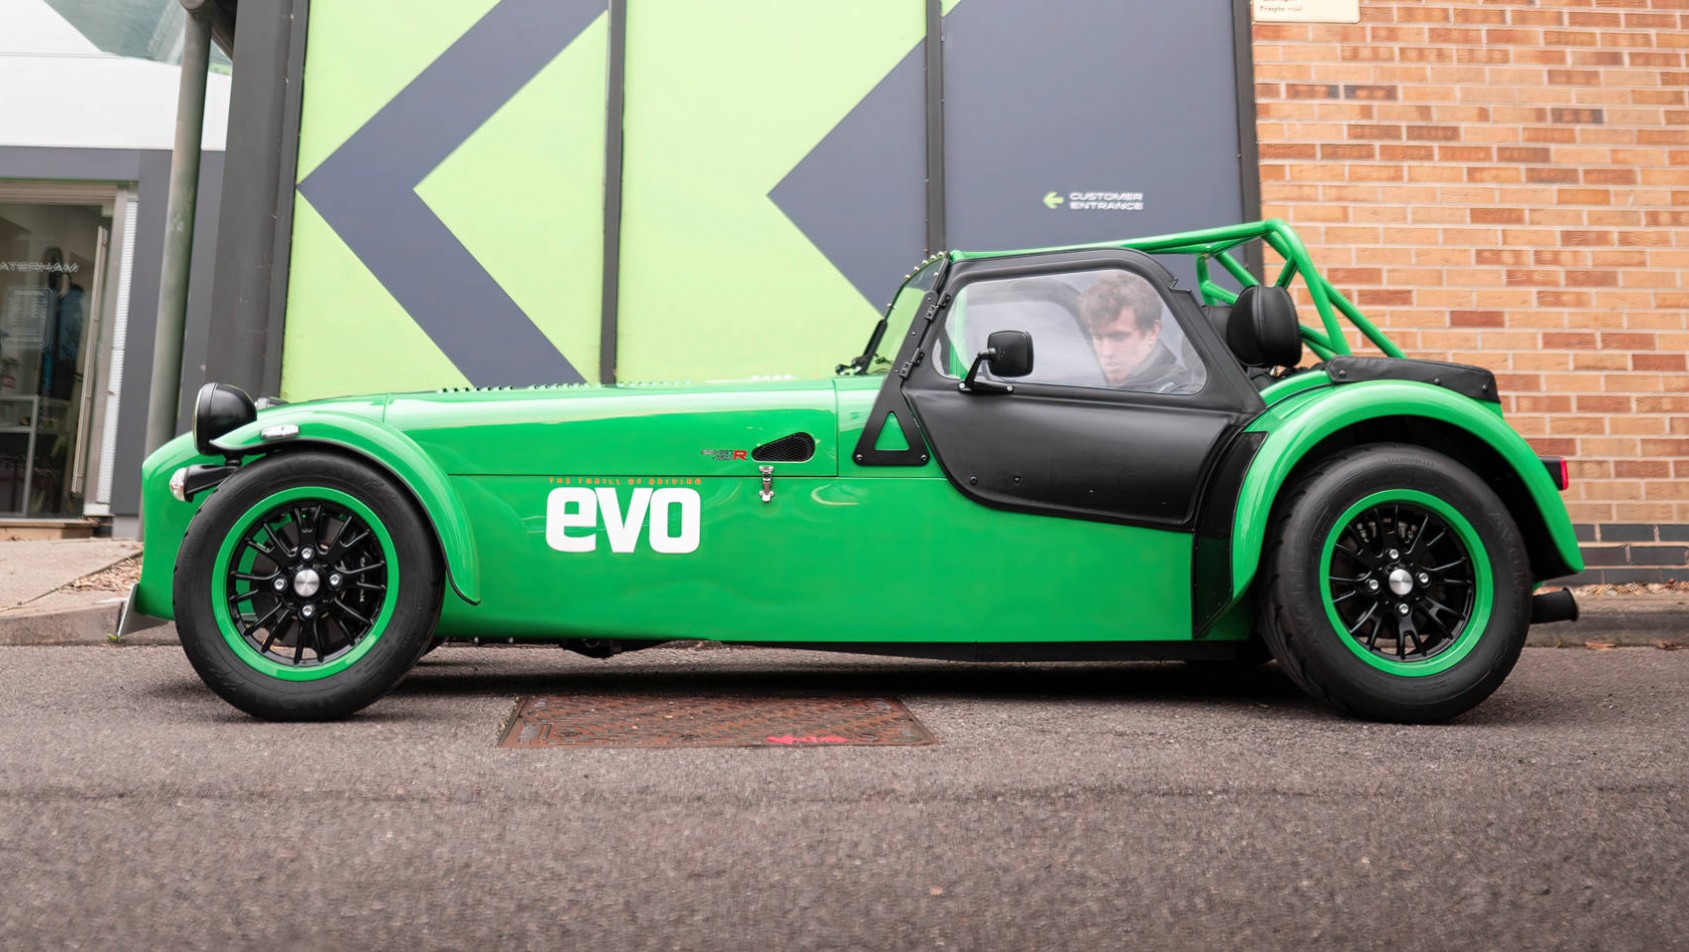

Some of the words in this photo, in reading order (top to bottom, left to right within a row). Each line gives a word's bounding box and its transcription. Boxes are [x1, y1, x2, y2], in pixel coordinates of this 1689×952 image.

[1069, 192, 1144, 200] CUSTOMER
[1069, 202, 1144, 210] ENTRANCE
[549, 477, 571, 485] THE
[577, 477, 621, 485] THRILL
[545, 487, 701, 554] evo
